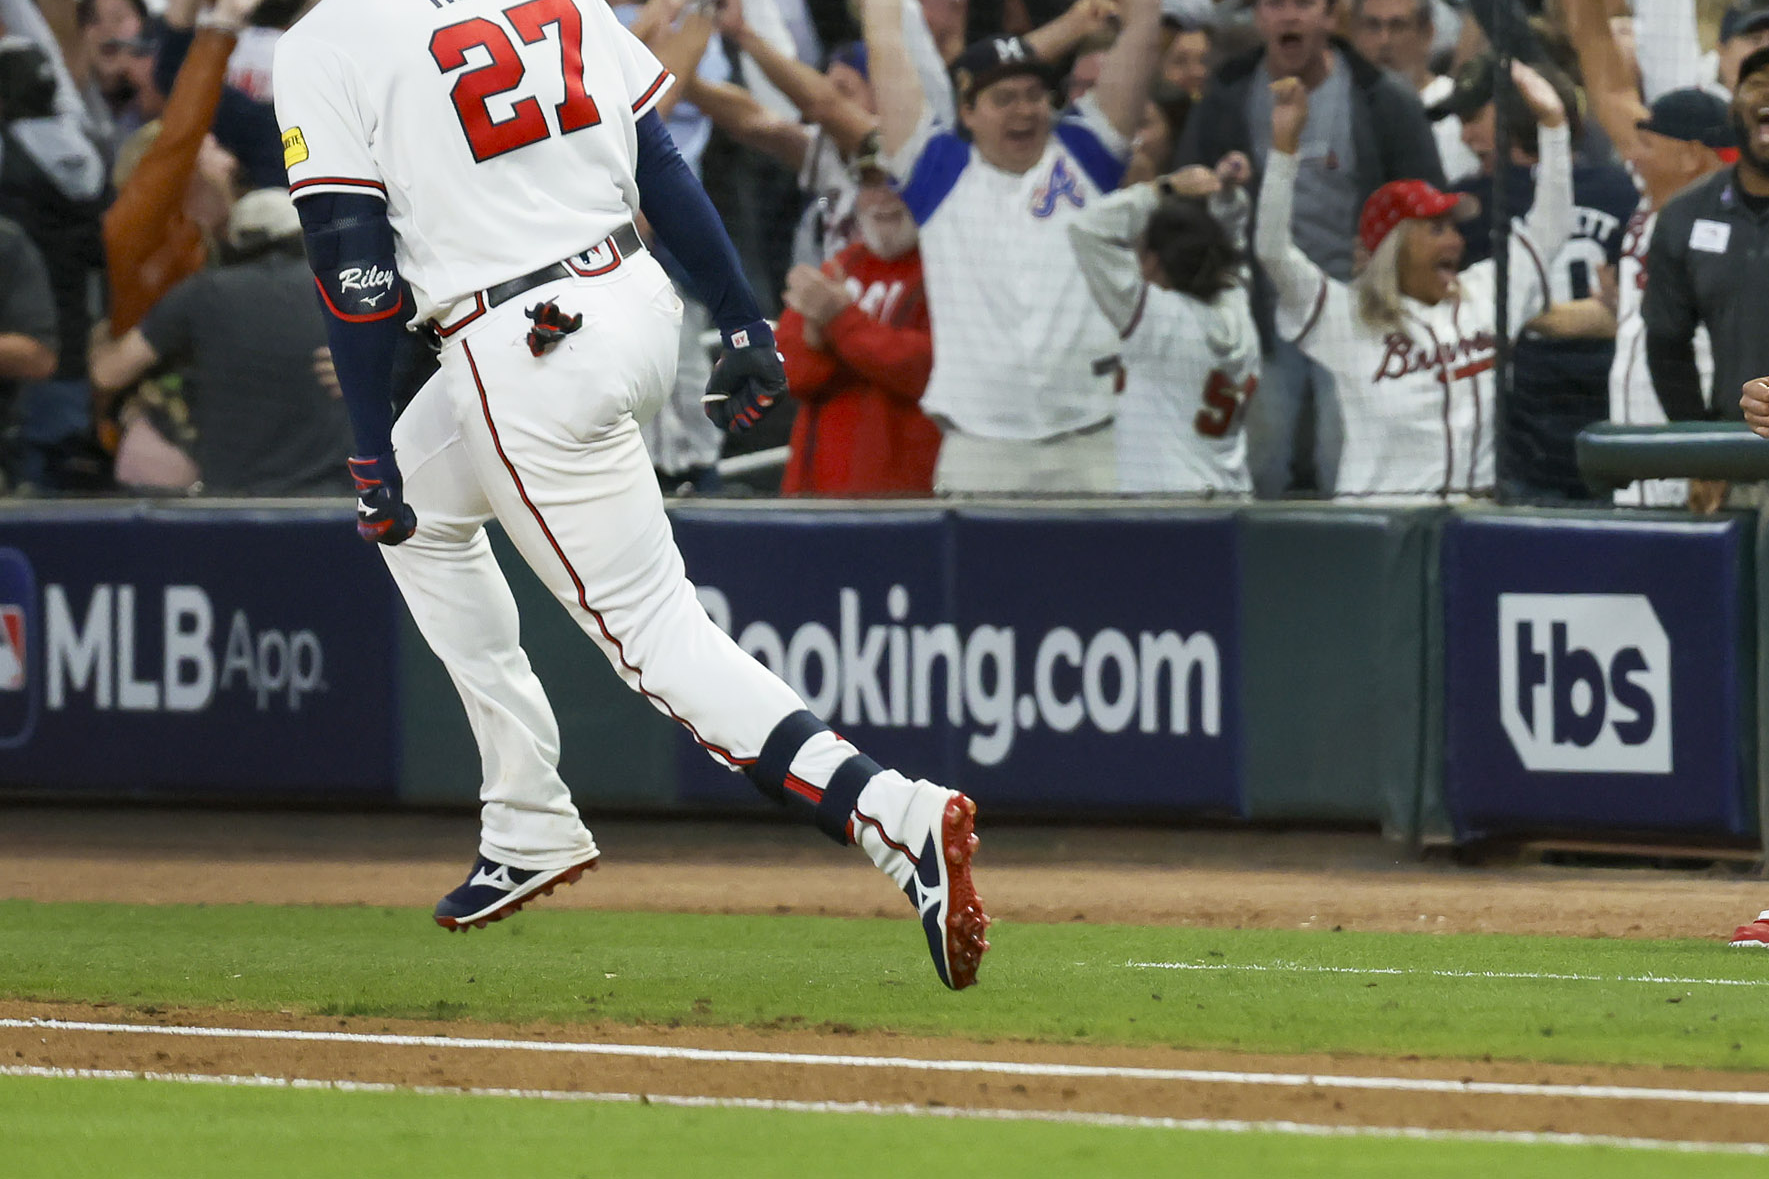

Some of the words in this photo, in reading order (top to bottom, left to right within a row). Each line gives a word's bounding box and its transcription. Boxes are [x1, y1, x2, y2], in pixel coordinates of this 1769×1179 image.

[338, 265, 395, 294] Riley
[45, 582, 216, 711] MLB
[219, 608, 324, 711] App
[1516, 620, 1656, 748] tbs
